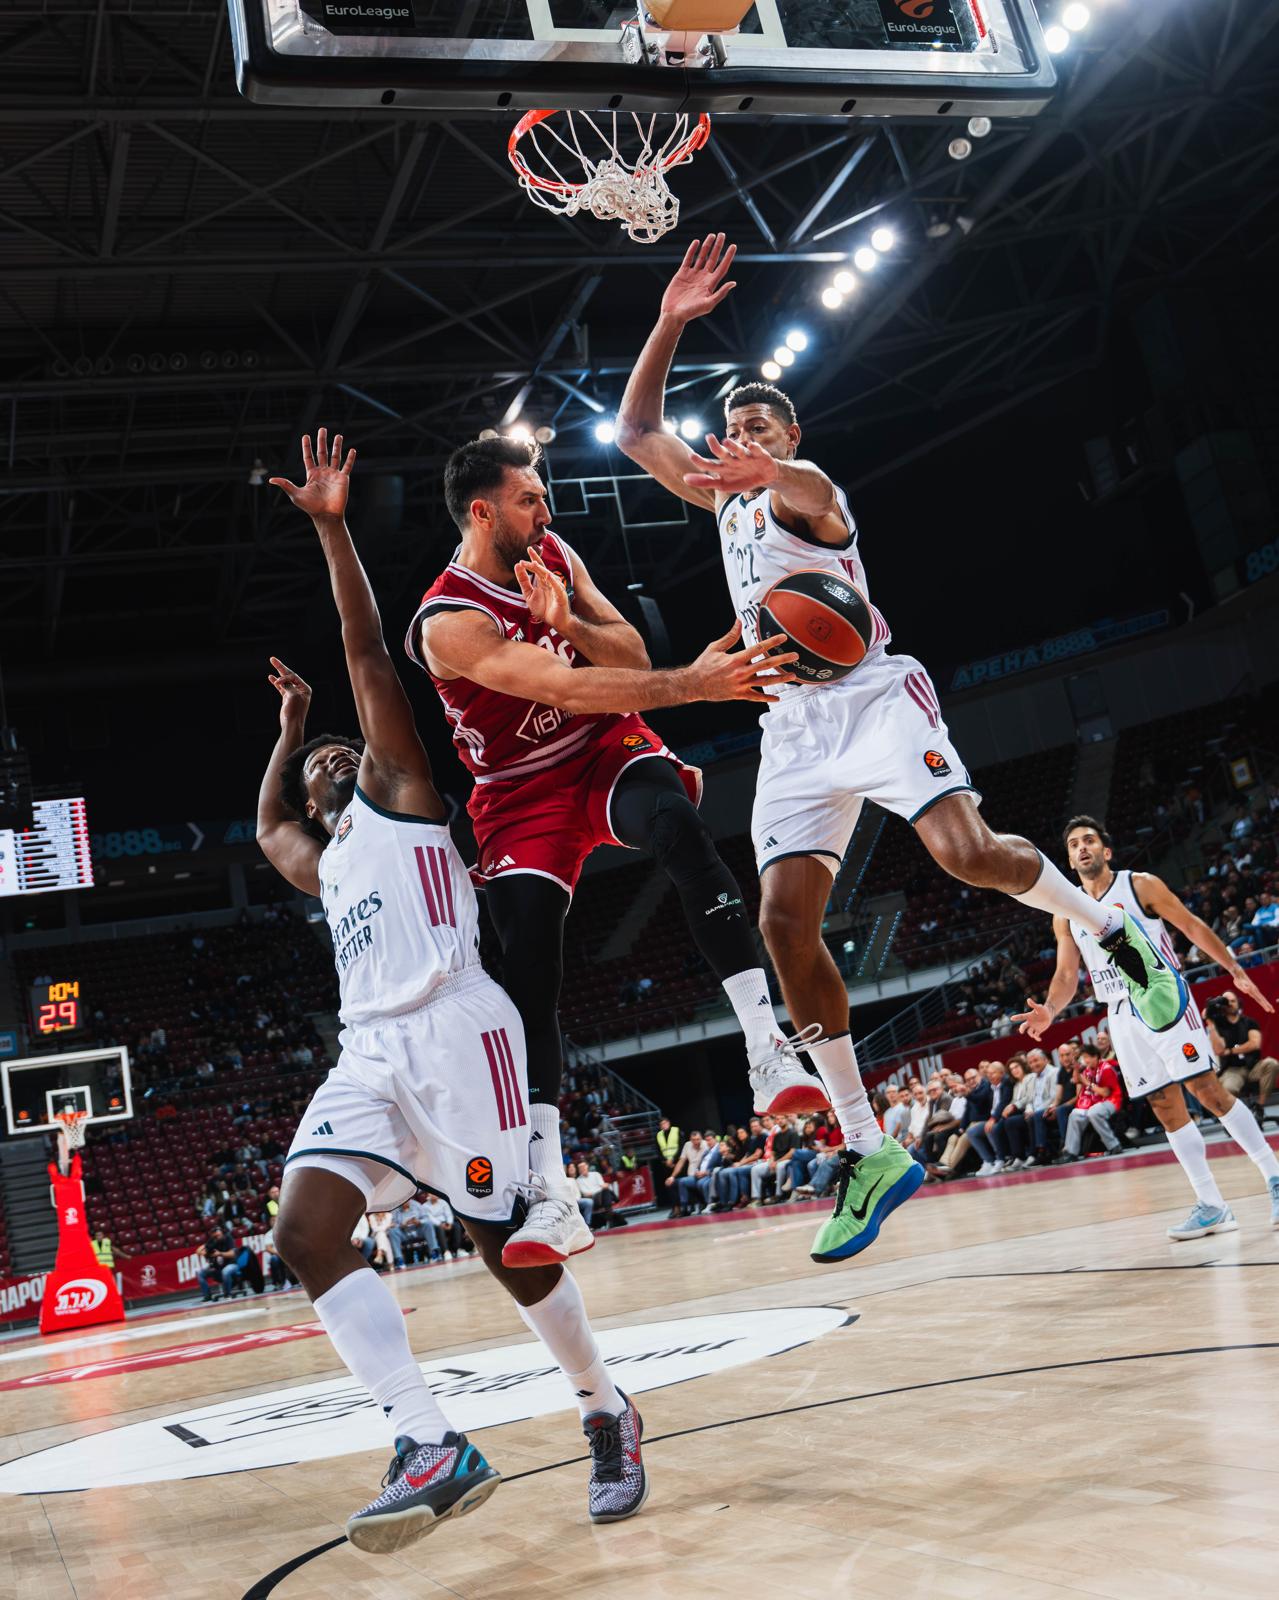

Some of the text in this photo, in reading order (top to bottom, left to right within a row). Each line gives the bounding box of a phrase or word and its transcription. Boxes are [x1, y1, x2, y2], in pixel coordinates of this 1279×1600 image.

[325, 4, 410, 20] EuroLeague
[887, 22, 956, 36] EuroLeague
[736, 543, 761, 589] 22
